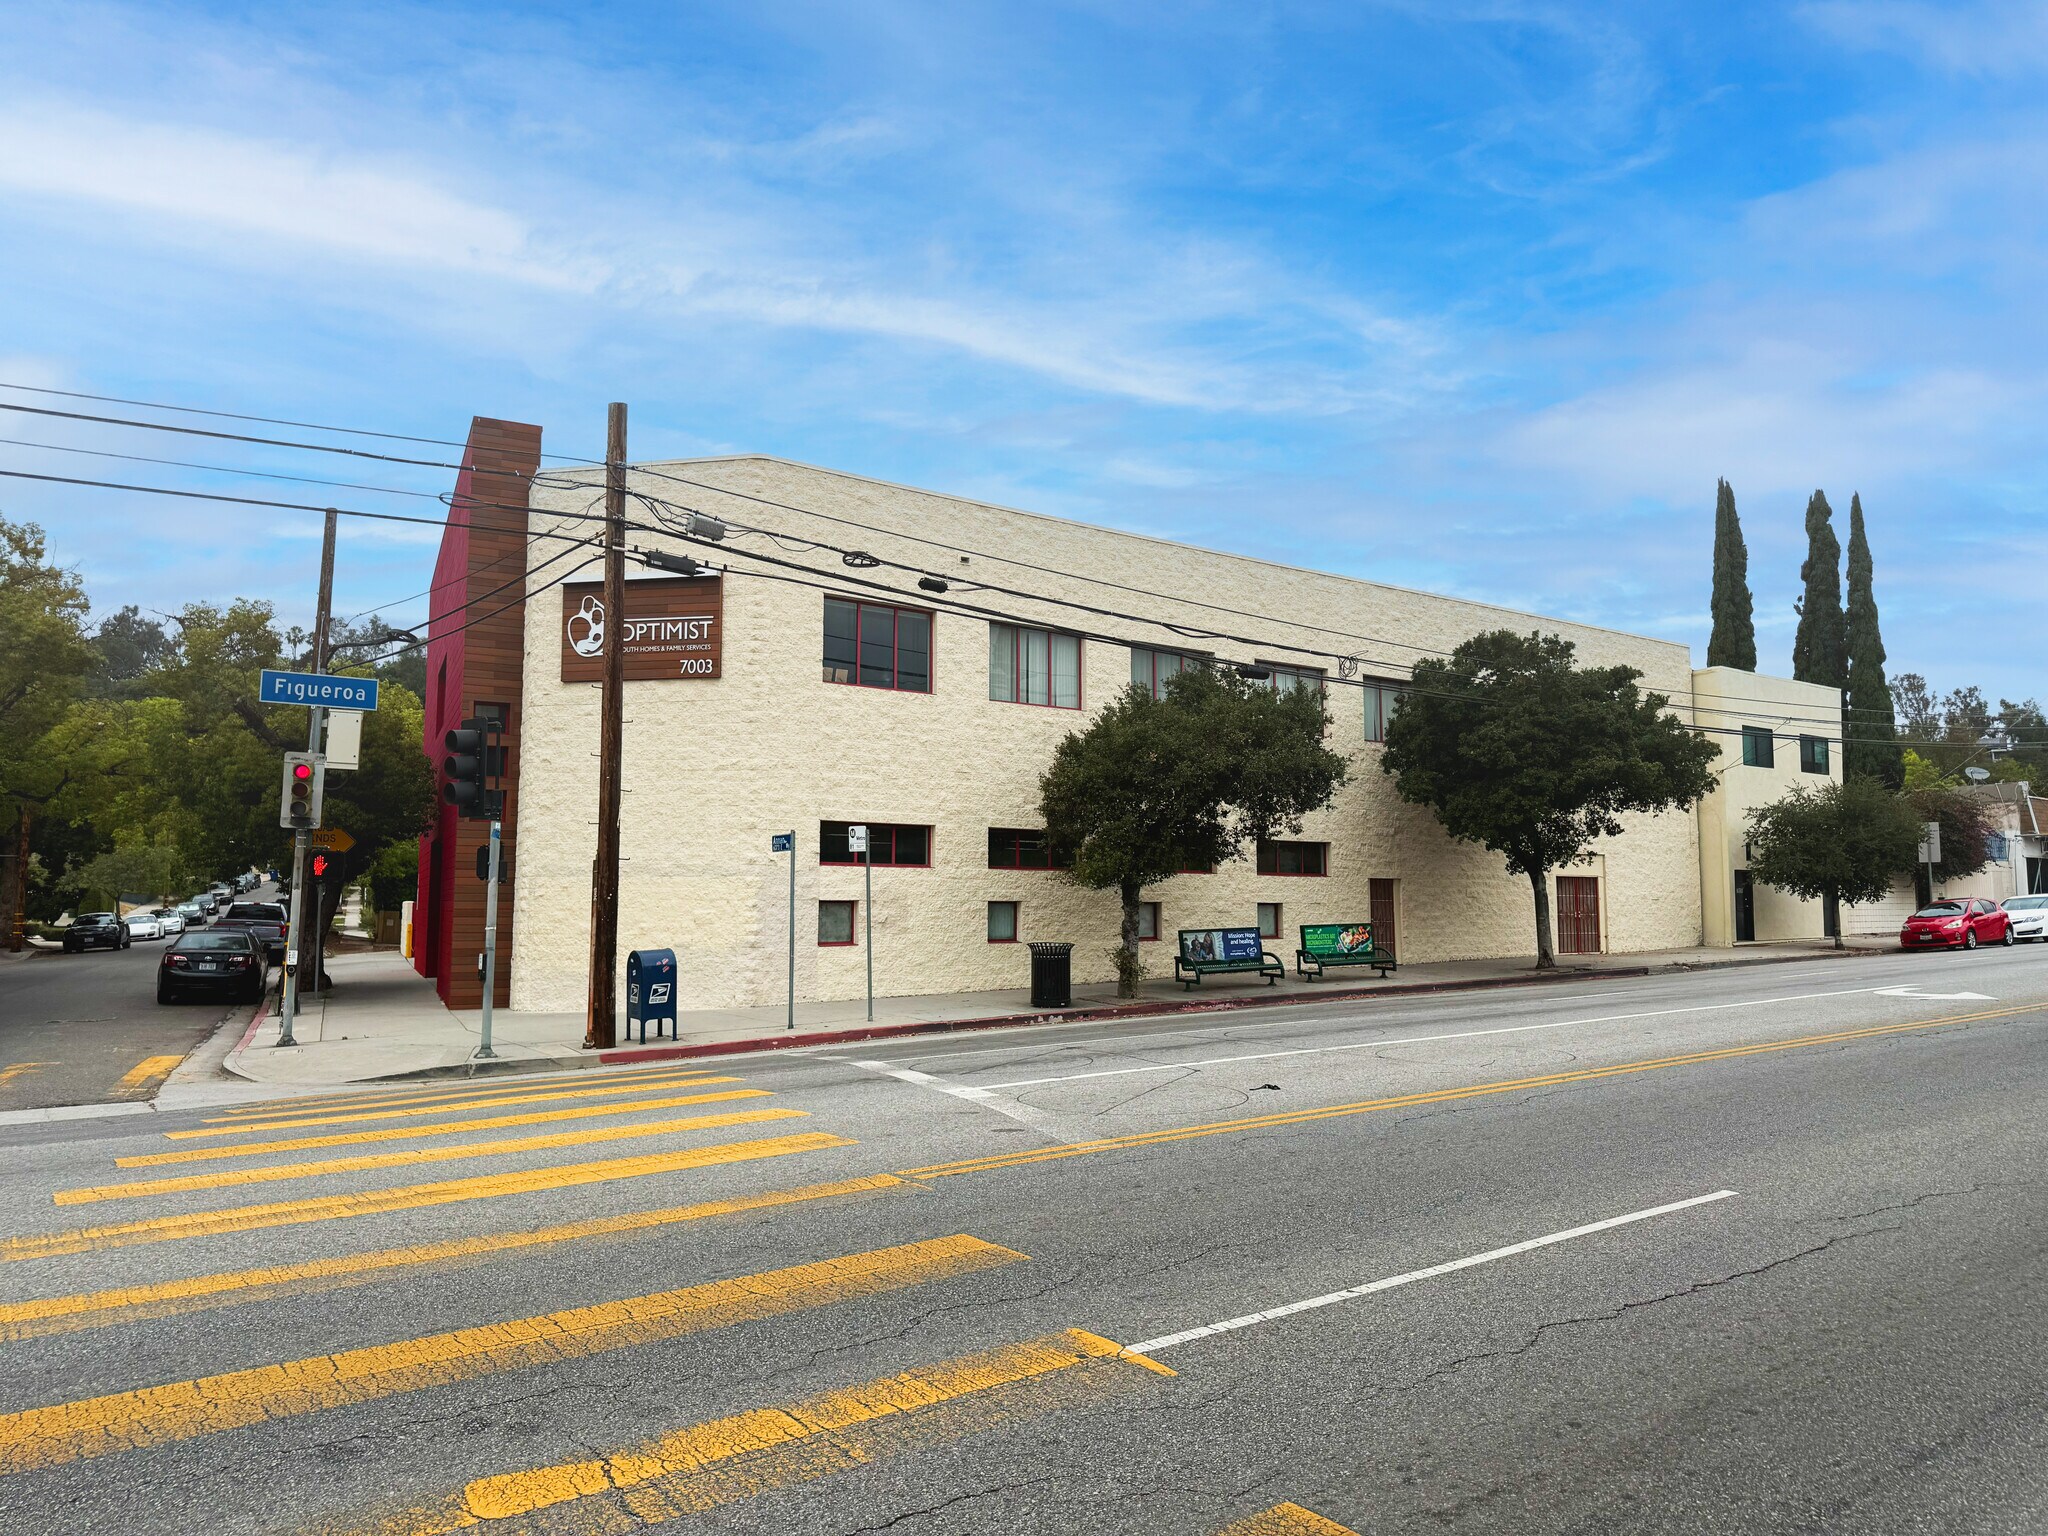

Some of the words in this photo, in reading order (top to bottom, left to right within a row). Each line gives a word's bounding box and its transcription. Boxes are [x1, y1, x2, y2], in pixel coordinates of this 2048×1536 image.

[623, 621, 714, 642] OPTIMIST
[686, 643, 712, 651] SERVICES
[680, 659, 713, 674] 7003
[274, 678, 366, 701] Figueroa
[312, 833, 337, 843] NDS
